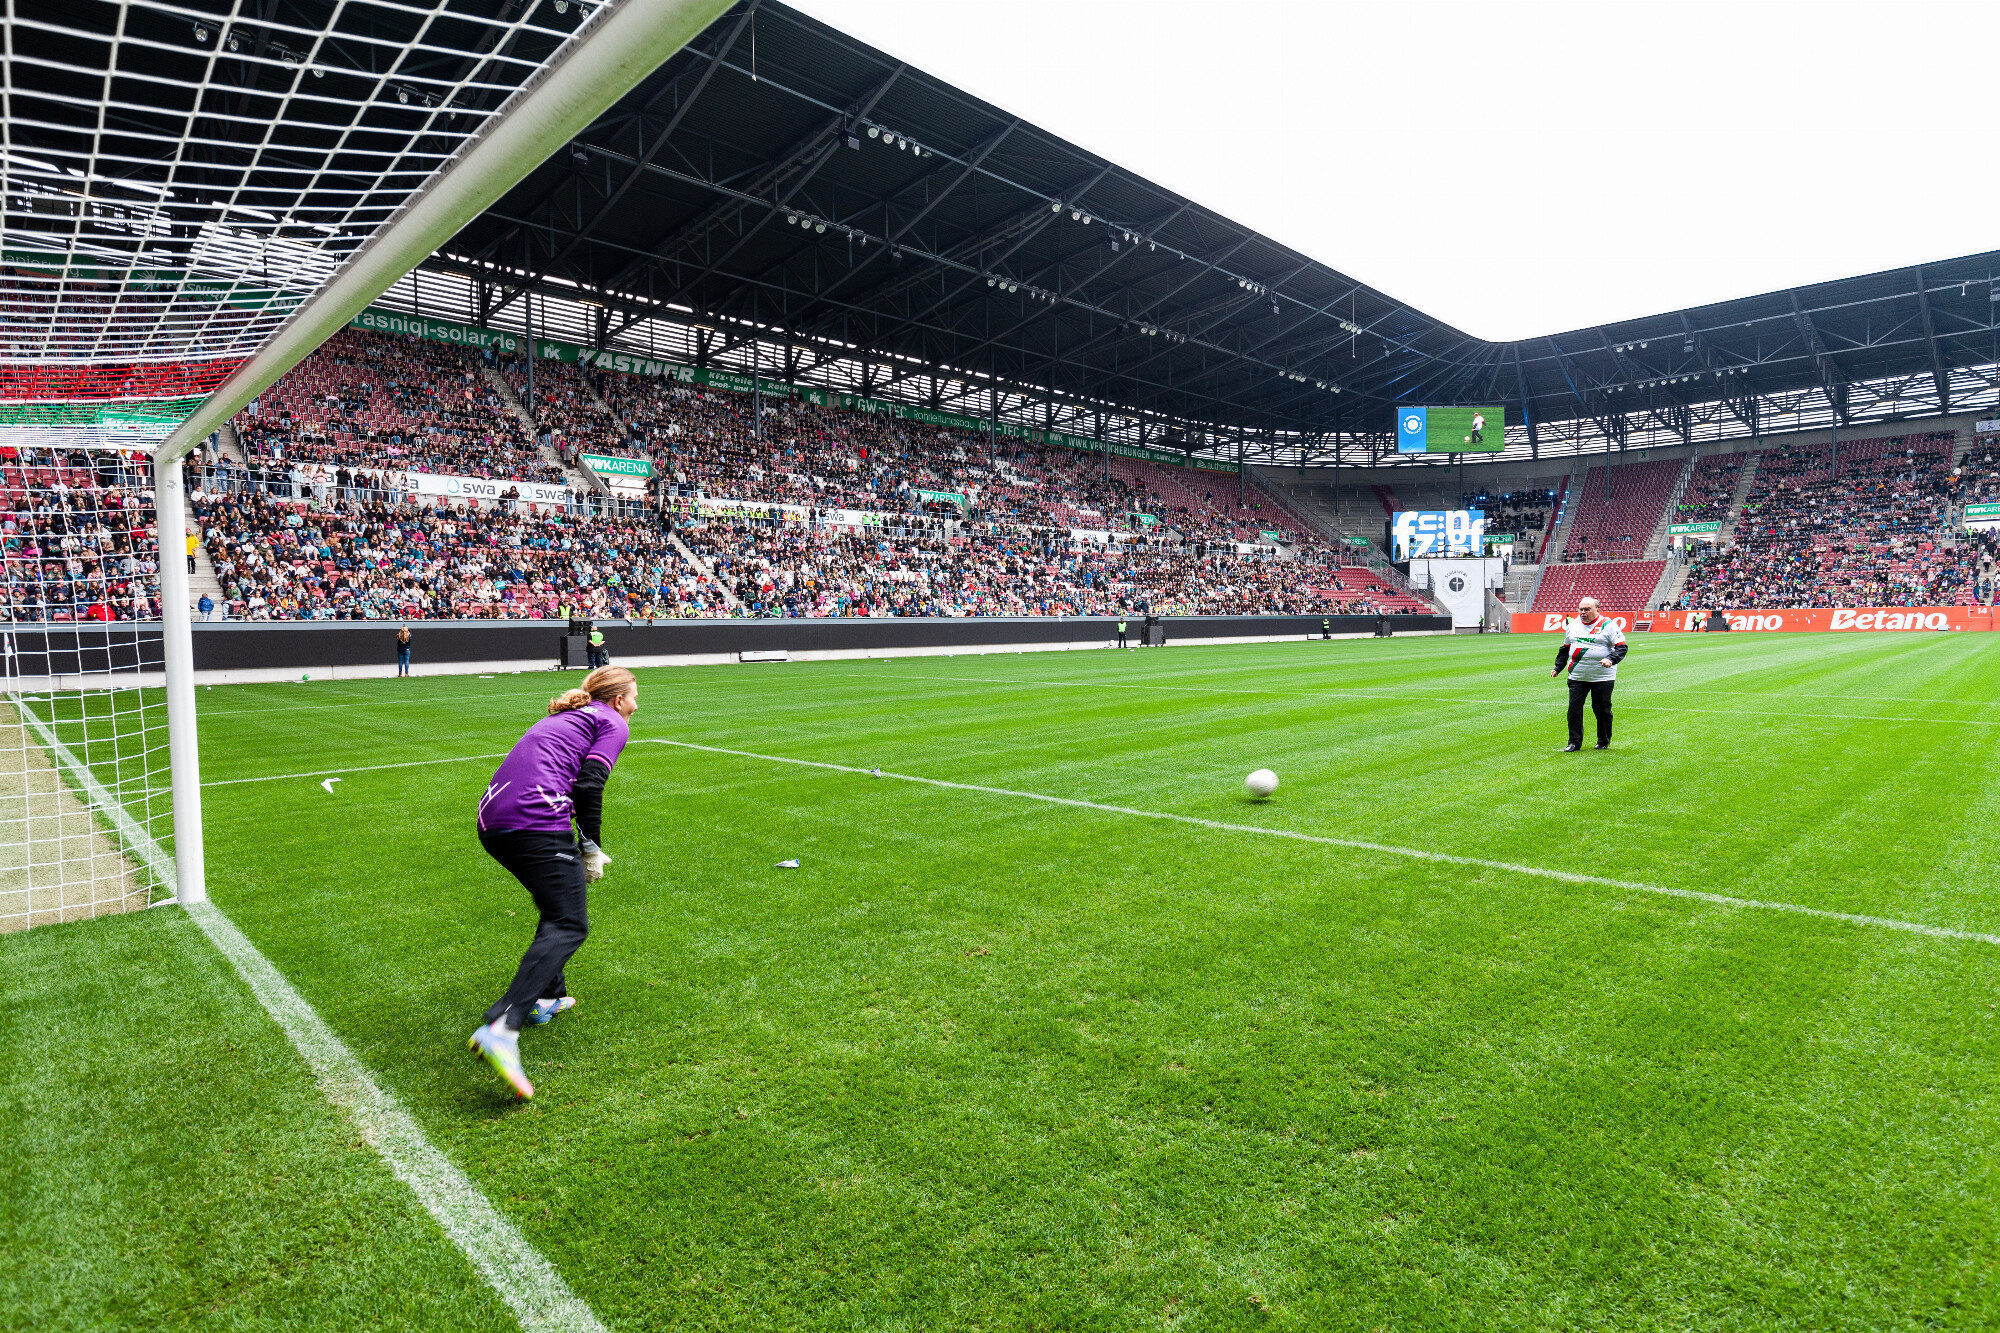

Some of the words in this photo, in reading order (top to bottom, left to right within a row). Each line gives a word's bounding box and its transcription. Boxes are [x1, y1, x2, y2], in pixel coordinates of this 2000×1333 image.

[578, 348, 695, 383] KASTNER
[462, 482, 496, 495] swa
[535, 488, 565, 501] swa
[1670, 524, 1718, 533] WWKARENA
[1829, 610, 1948, 631] Betano
